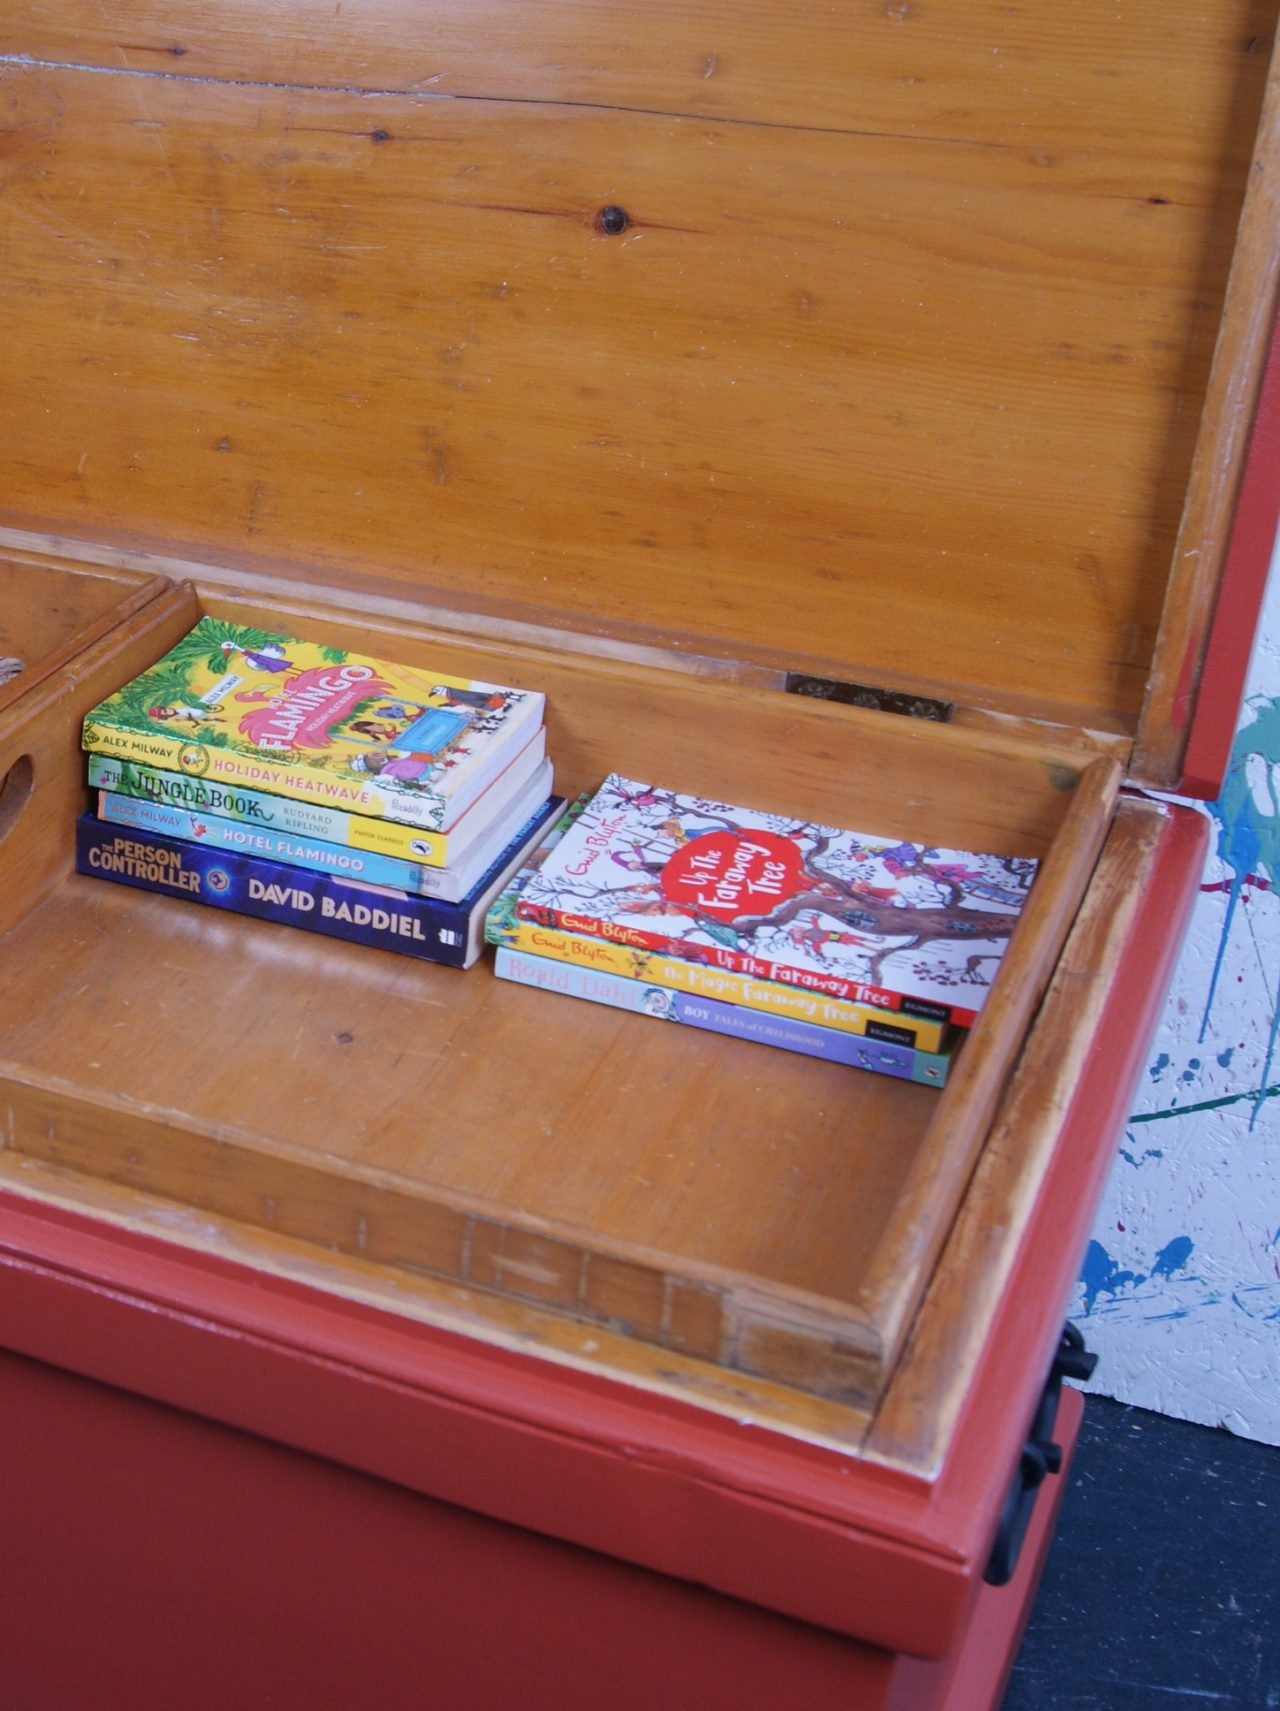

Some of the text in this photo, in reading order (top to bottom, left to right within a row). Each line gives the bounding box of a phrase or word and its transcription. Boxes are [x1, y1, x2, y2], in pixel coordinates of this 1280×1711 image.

[259, 665, 373, 750] FLAMINGO
[103, 736, 173, 757] ALEX MILWAY
[104, 770, 274, 821] THE JUNGLE BOOK
[214, 759, 369, 803] HOLIDAY HEATWAVE
[111, 803, 182, 826] ALEX MILWAY
[283, 807, 332, 825] RUDYARD
[285, 819, 329, 834] KIPLING
[102, 843, 114, 852] THE
[114, 838, 181, 869] PERSON
[223, 829, 365, 872] HOTEL FLAMINGO
[564, 815, 626, 876] Enid Blyton
[88, 847, 201, 893] CONTROLLER
[679, 849, 722, 886] Up The
[697, 841, 772, 909] Faraway
[745, 861, 787, 895] Tree
[248, 878, 315, 911] DAVID
[321, 897, 426, 940] BADDIEL
[561, 913, 649, 945] Enid Blyton
[531, 932, 617, 966] Enid Blyton
[508, 958, 638, 1009] Roald Dahl
[688, 969, 738, 992] Magic
[742, 982, 819, 1016] Faraway
[821, 1002, 861, 1023] Tree
[740, 957, 766, 975] The
[770, 963, 849, 997] Faraway
[853, 984, 891, 1007] Tree
[683, 1005, 711, 1021] BOY
[904, 1002, 947, 1018] EGMONT
[870, 1028, 911, 1044] EGMONT
